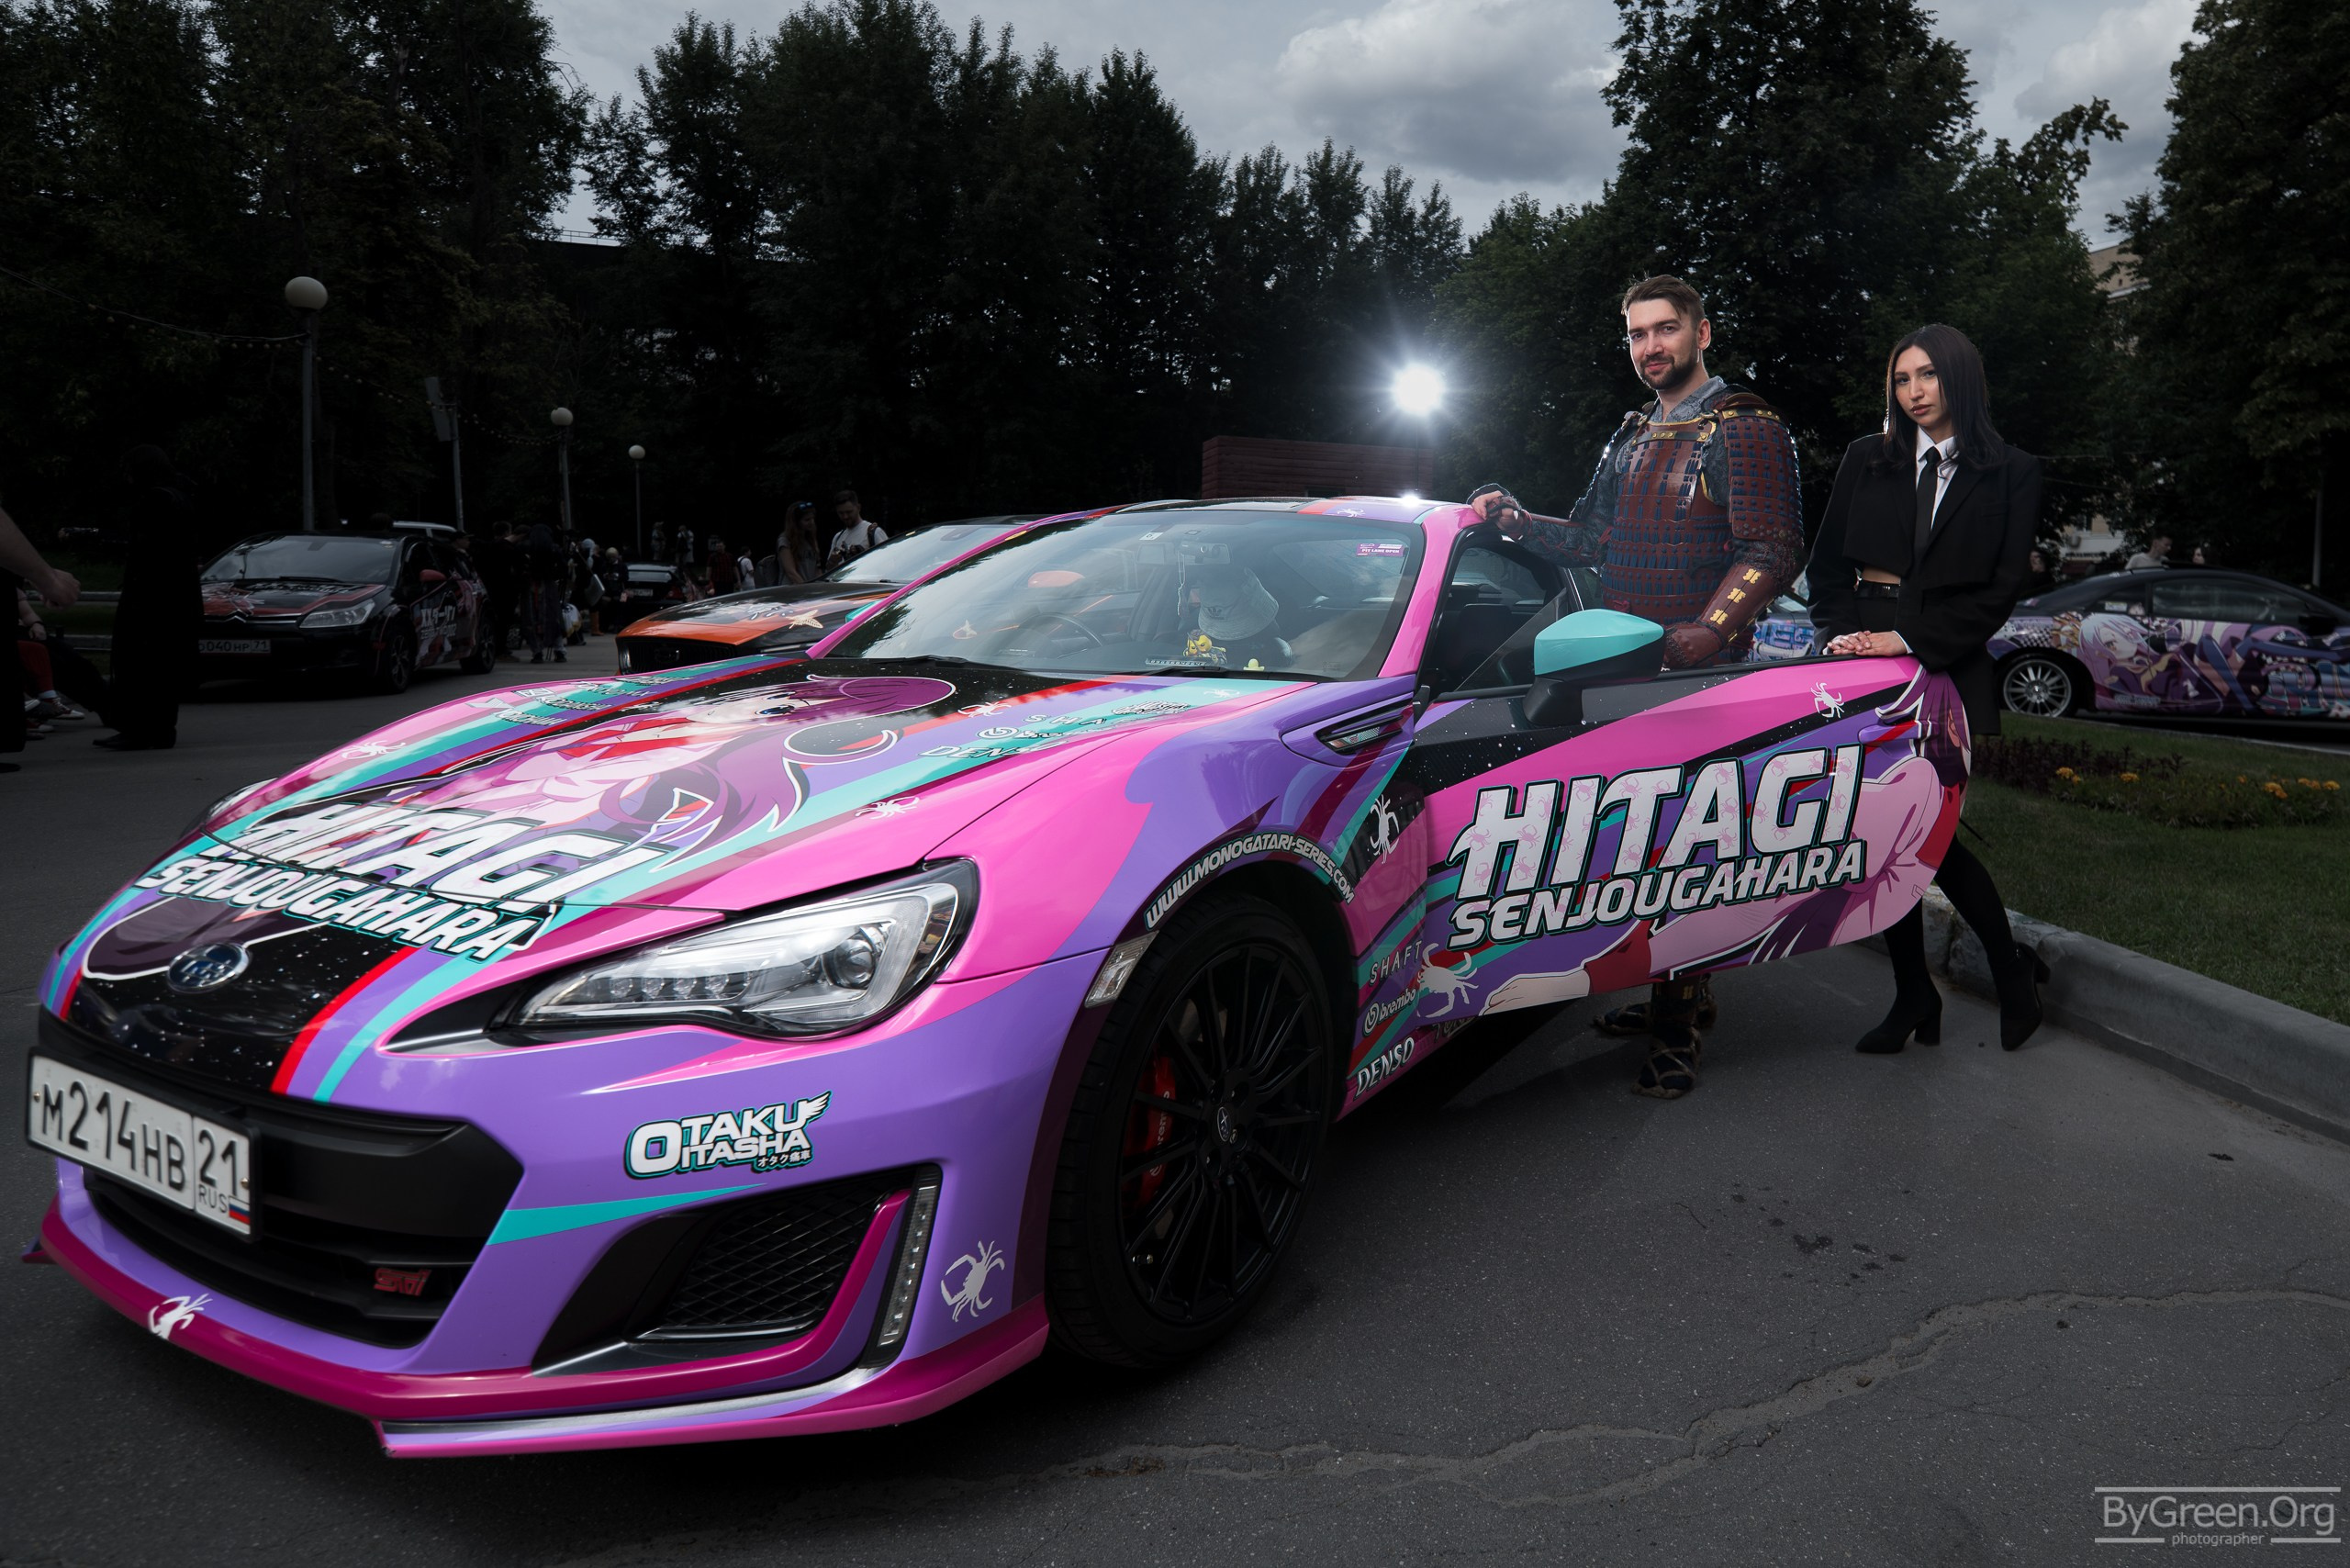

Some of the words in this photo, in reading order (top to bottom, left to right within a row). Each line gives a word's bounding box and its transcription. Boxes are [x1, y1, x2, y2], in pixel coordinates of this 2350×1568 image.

[252, 640, 268, 650] 71
[1446, 745, 1863, 901] HITAGI
[204, 803, 672, 913] HITAGI
[138, 857, 535, 958] SENJOUGAHARA
[1448, 846, 1863, 948] SENJOUGAHARA
[1369, 940, 1423, 985] SHAFT
[1379, 988, 1416, 1023] brembo
[1355, 1037, 1416, 1098] DENSO
[197, 1129, 239, 1198] 21
[630, 1096, 811, 1174] OTAKU
[680, 1128, 811, 1169] ITASHA
[756, 1149, 811, 1168] オタク痛車
[197, 1183, 229, 1215] RUS
